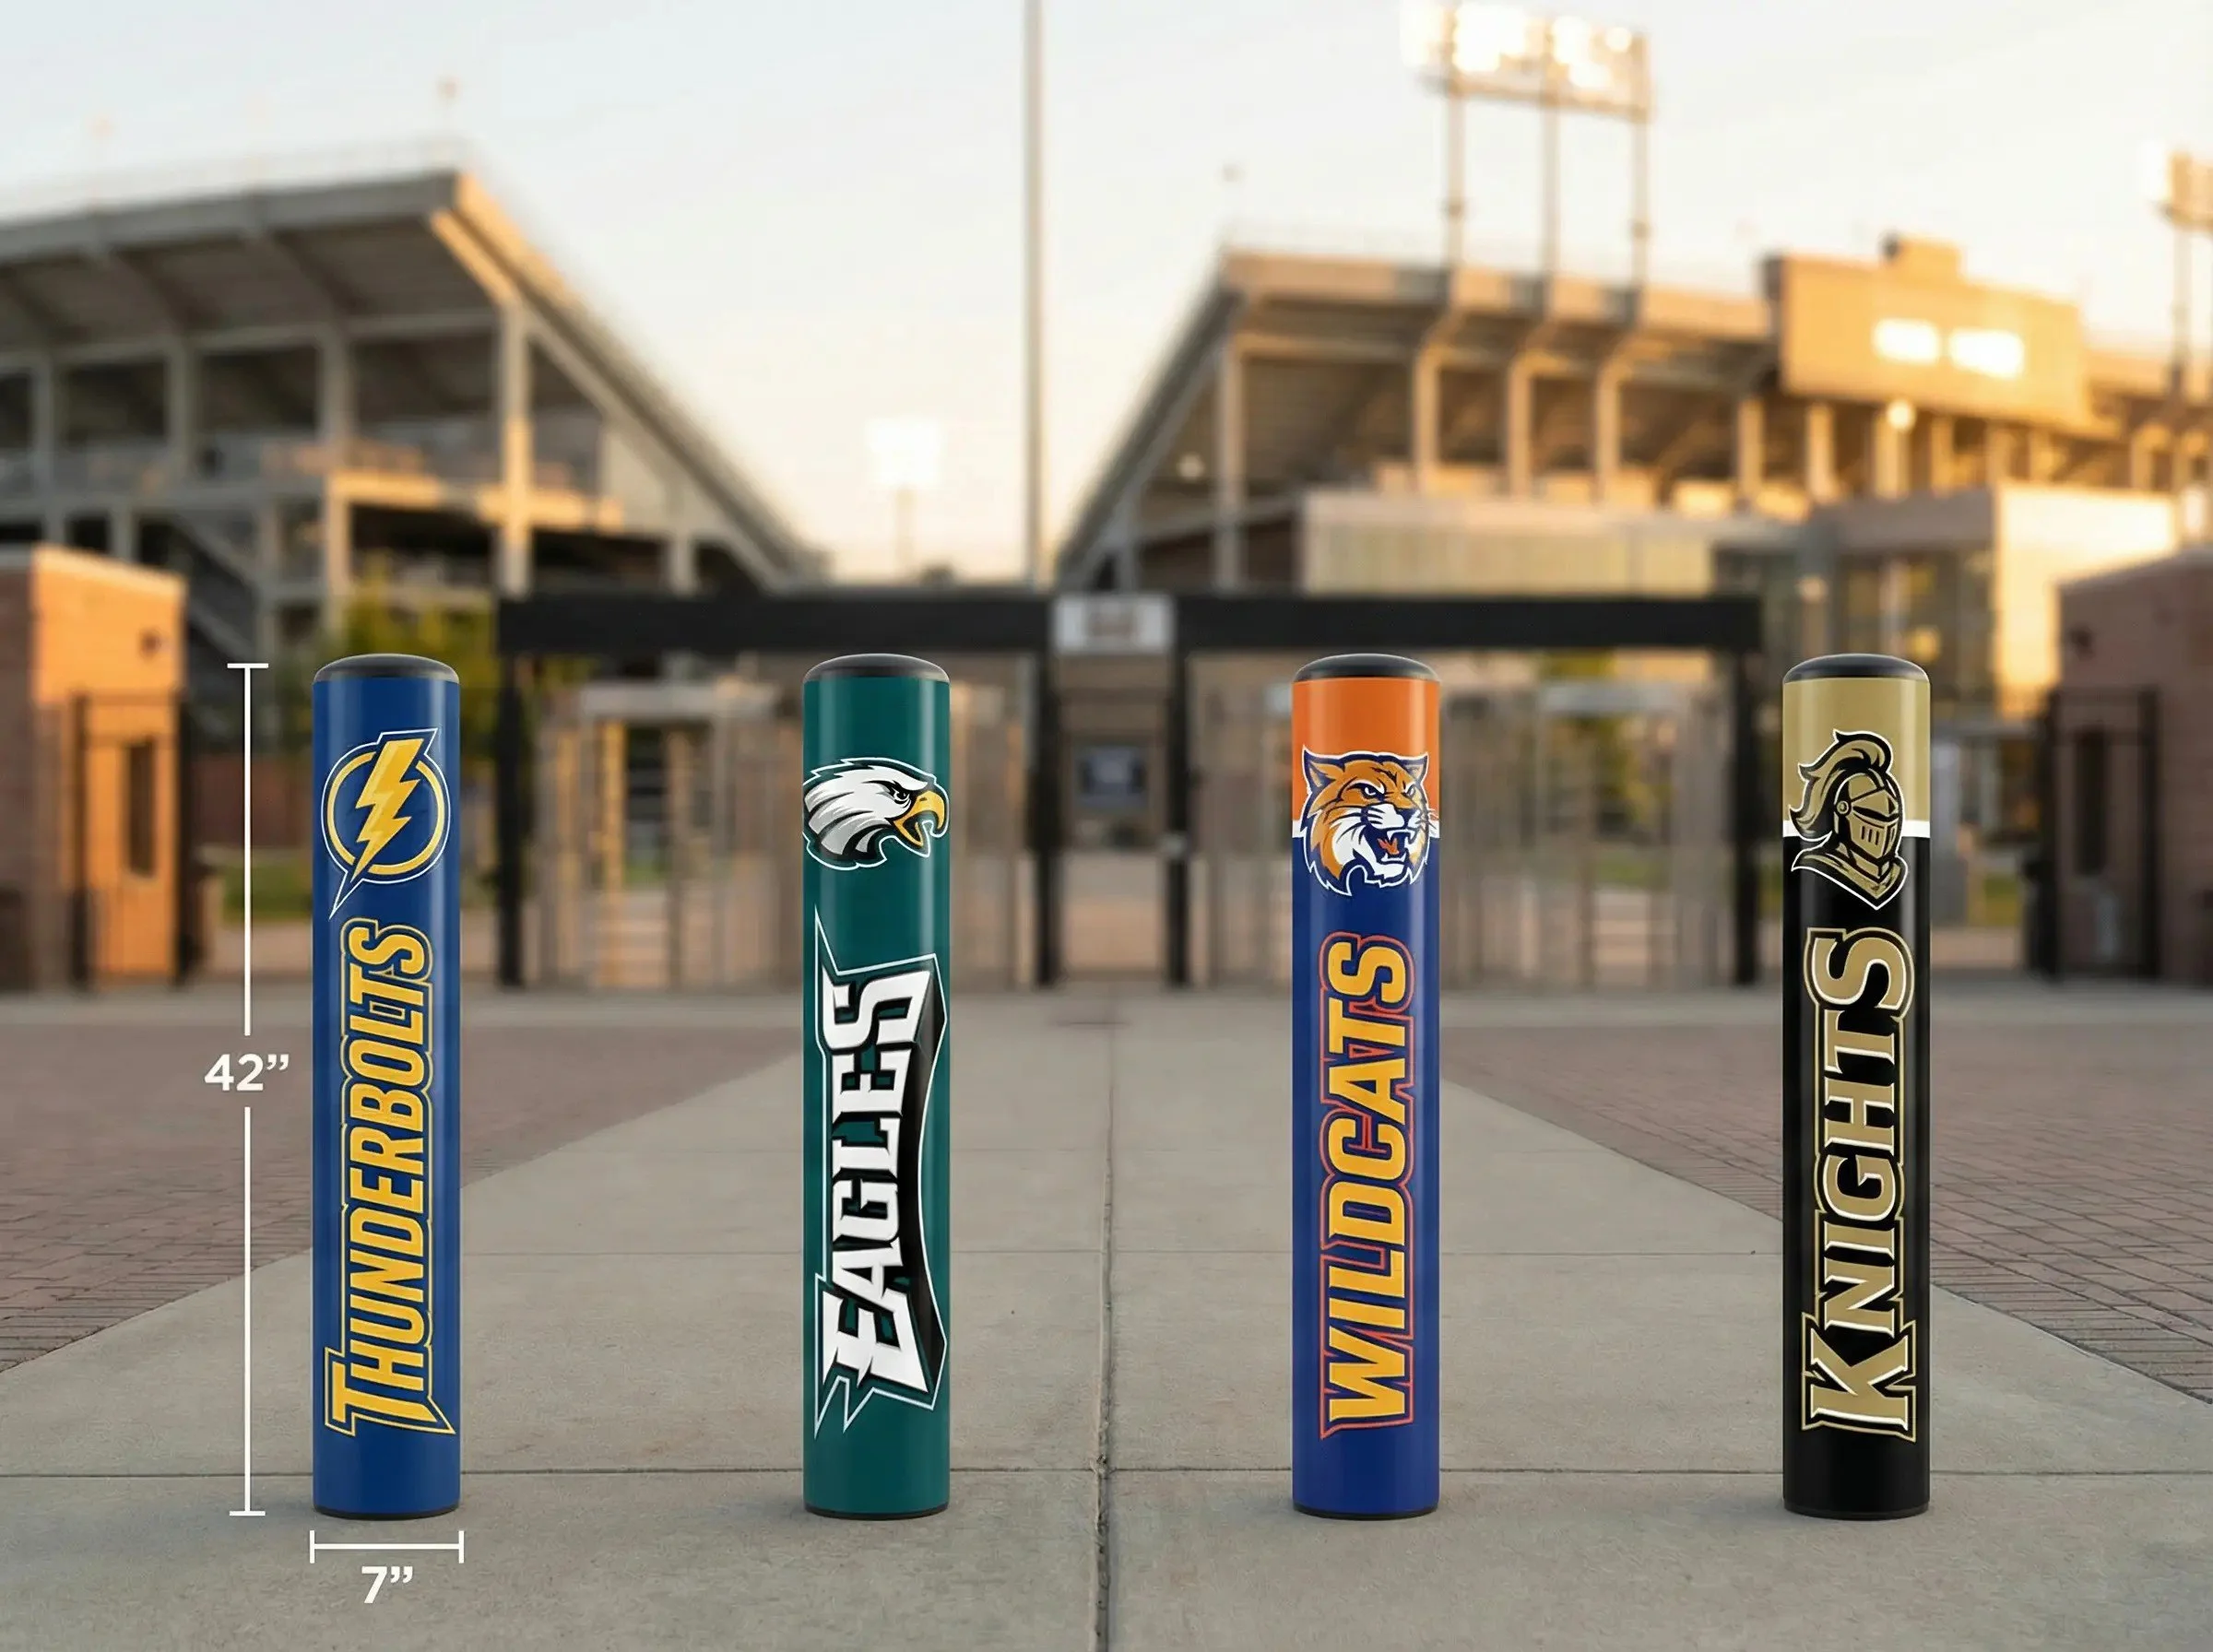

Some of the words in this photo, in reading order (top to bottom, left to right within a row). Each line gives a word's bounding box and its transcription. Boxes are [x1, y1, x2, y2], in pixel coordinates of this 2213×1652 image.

[330, 925, 441, 1426] THUNDERBOLTS
[820, 962, 933, 1395] EAGLES
[1326, 938, 1409, 1425] WILDCATS
[1808, 934, 1911, 1433] KNIGHTS
